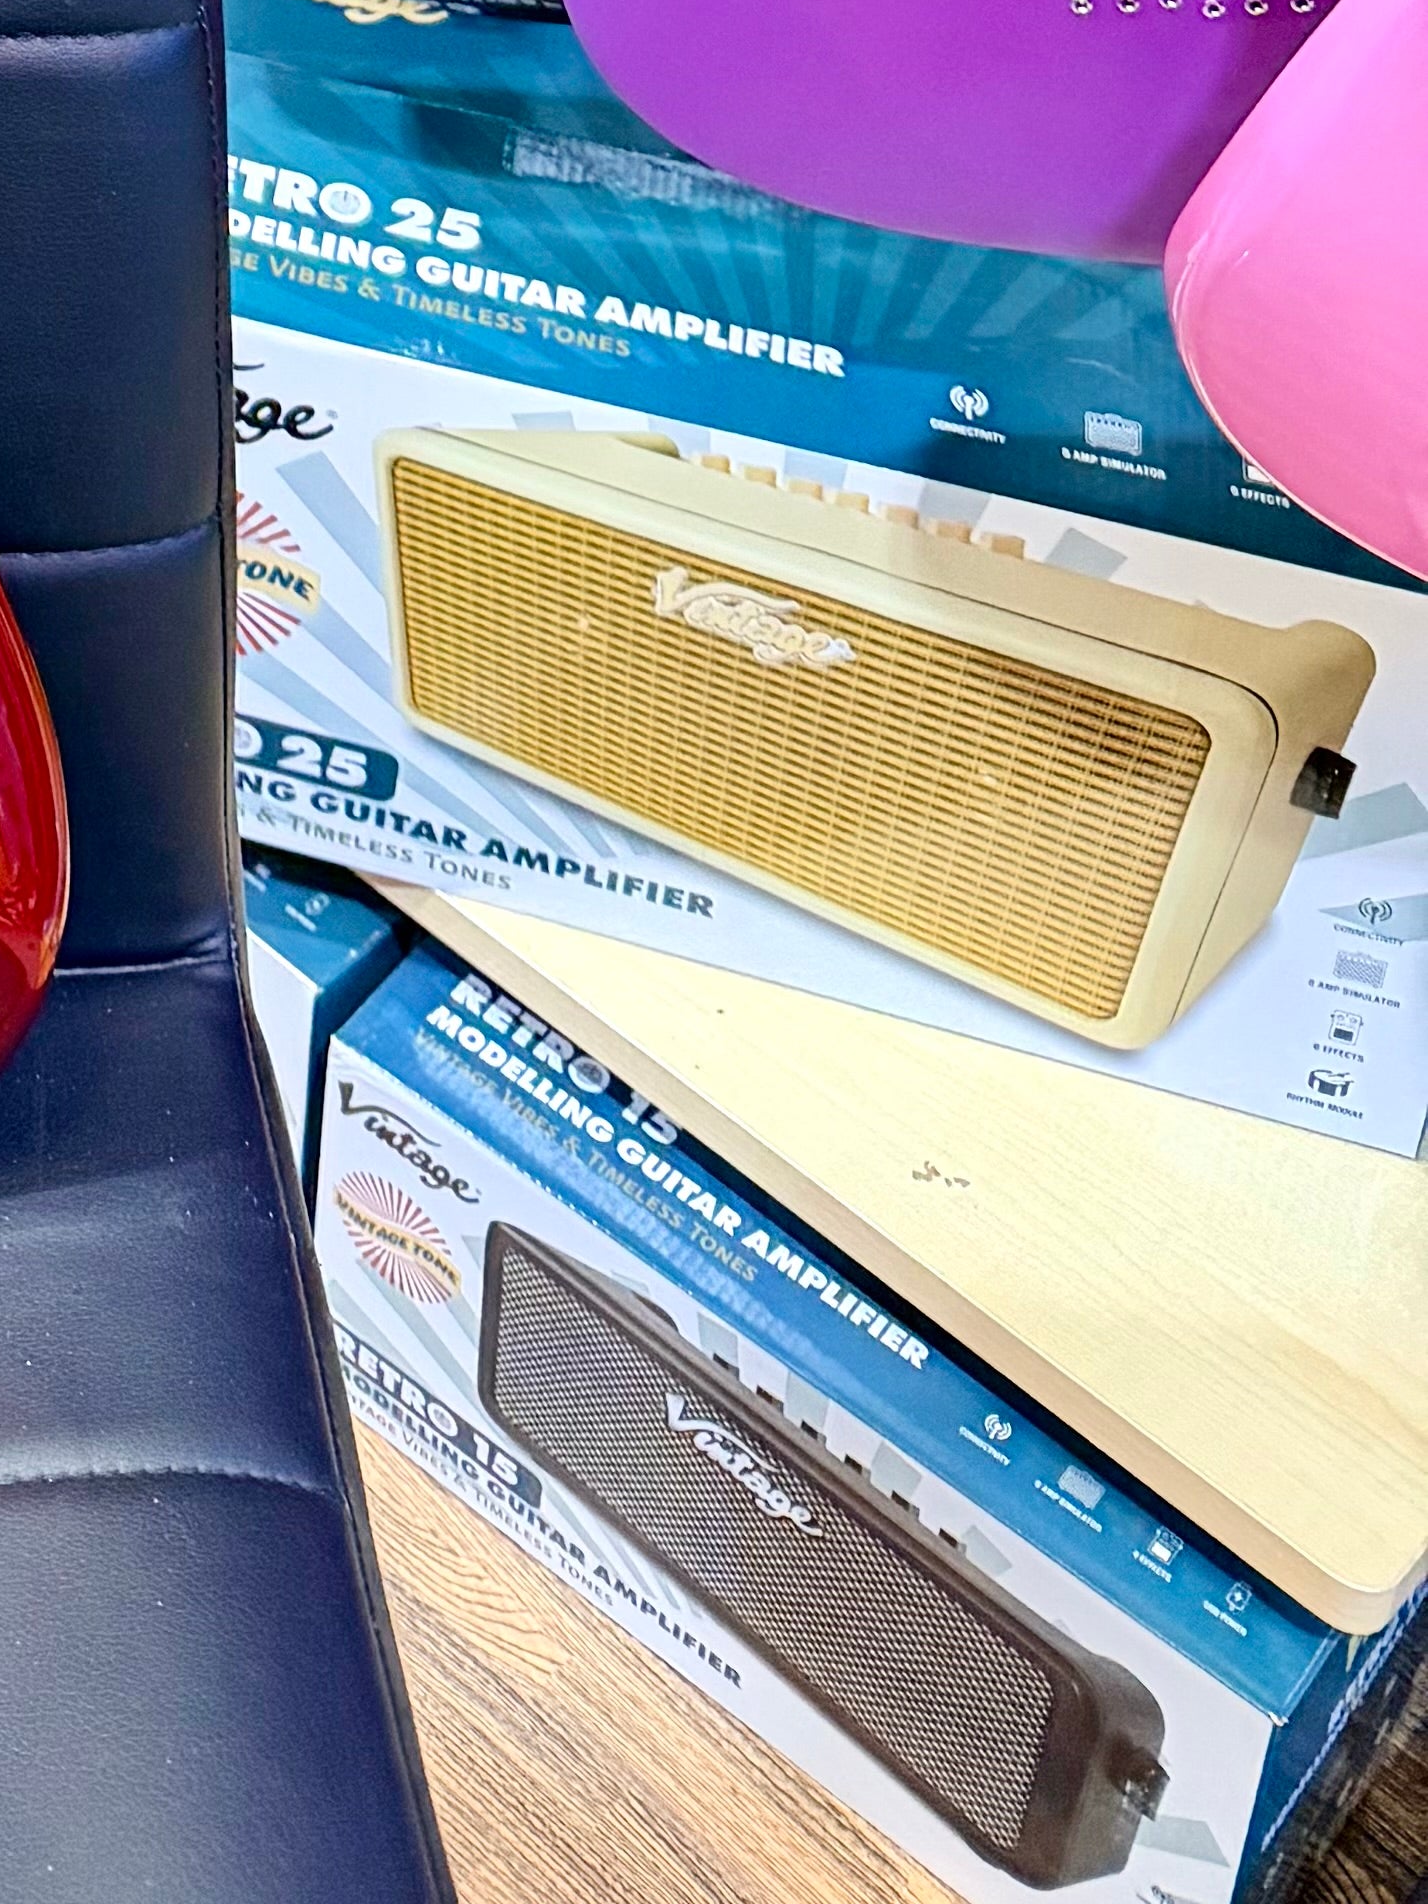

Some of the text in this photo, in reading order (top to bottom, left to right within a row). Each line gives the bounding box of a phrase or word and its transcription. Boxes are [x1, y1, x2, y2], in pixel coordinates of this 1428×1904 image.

[384, 197, 483, 252] 25
[268, 253, 348, 295] VIBES
[390, 282, 527, 335] TIMELESS
[537, 316, 632, 359] TONES
[415, 255, 846, 379] GUITAR AMPLIFIER
[276, 735, 368, 788] 25
[284, 808, 512, 890] TIMELESS TONES
[309, 791, 715, 919] GUITAR AMPLIFIER
[450, 972, 612, 1095] RETRO
[338, 1080, 481, 1204] Vintage
[425, 1004, 932, 1371] MODELLING GUITAR AMPLIFIER
[689, 1222, 759, 1283] TONES
[337, 1330, 519, 1488] RETRO 15
[664, 1391, 825, 1539] Vintage
[487, 1479, 743, 1691] GUITAR AMPLIFIER
[558, 1556, 615, 1608] TONES
